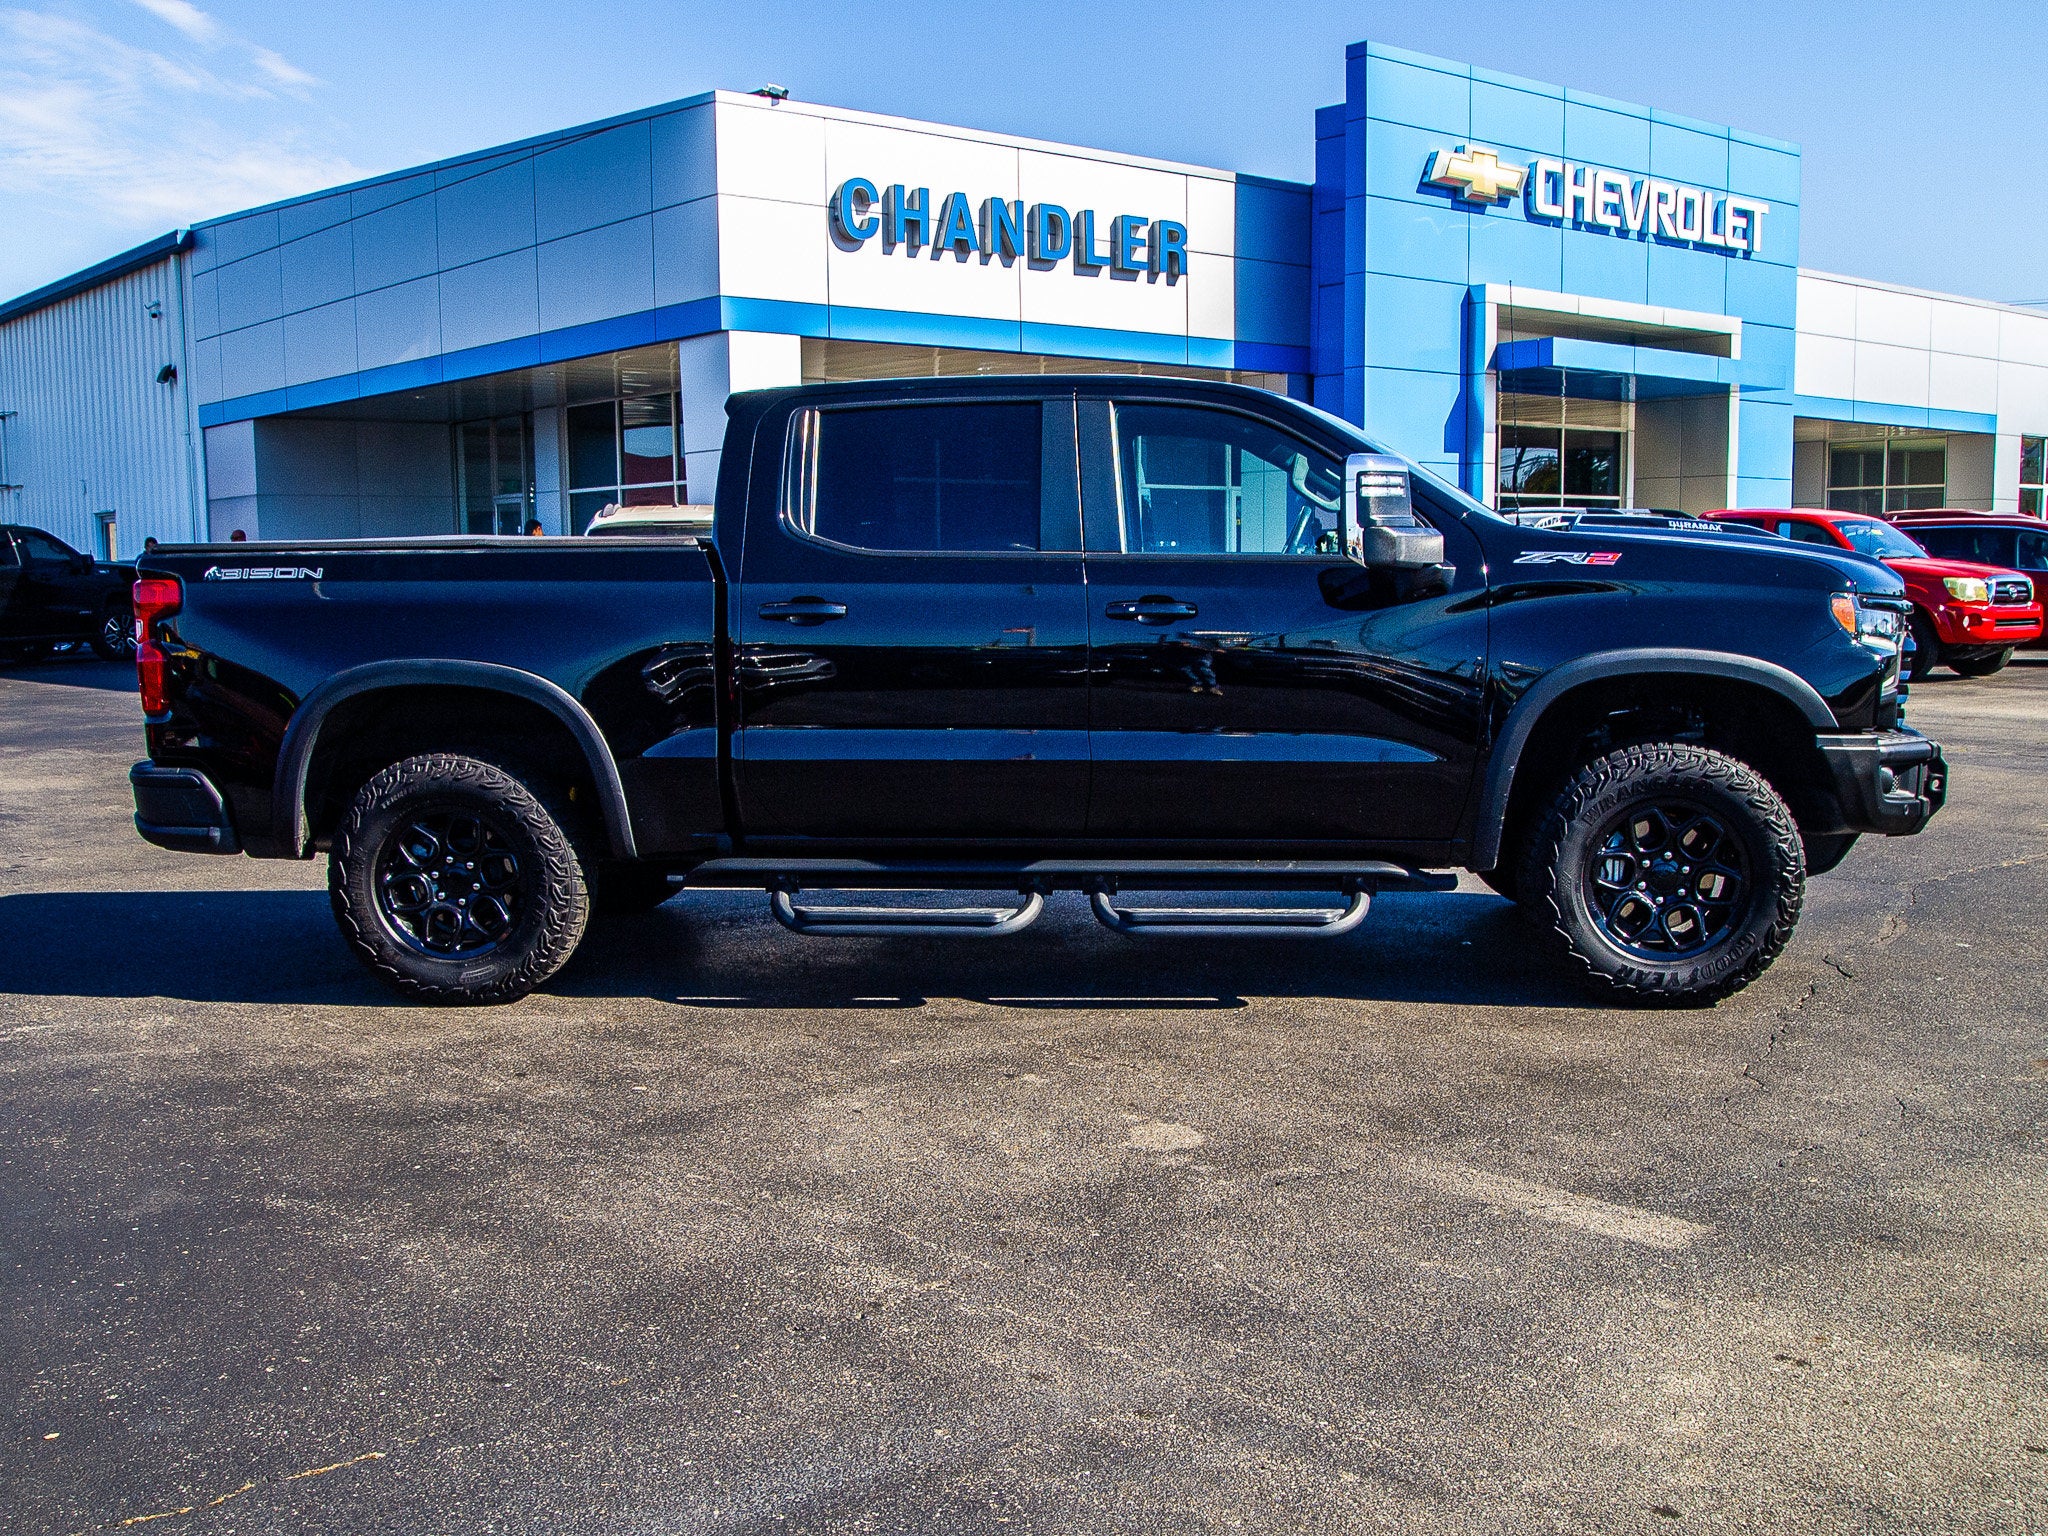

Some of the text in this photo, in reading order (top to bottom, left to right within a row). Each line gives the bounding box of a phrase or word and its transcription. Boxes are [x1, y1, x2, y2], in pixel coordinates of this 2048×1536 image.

[1526, 158, 1770, 254] CHEVROLET
[830, 177, 1188, 278] CHANDLER
[1668, 520, 1723, 532] DURAMAX
[1513, 551, 1623, 566] ZR2
[220, 567, 324, 580] BISON
